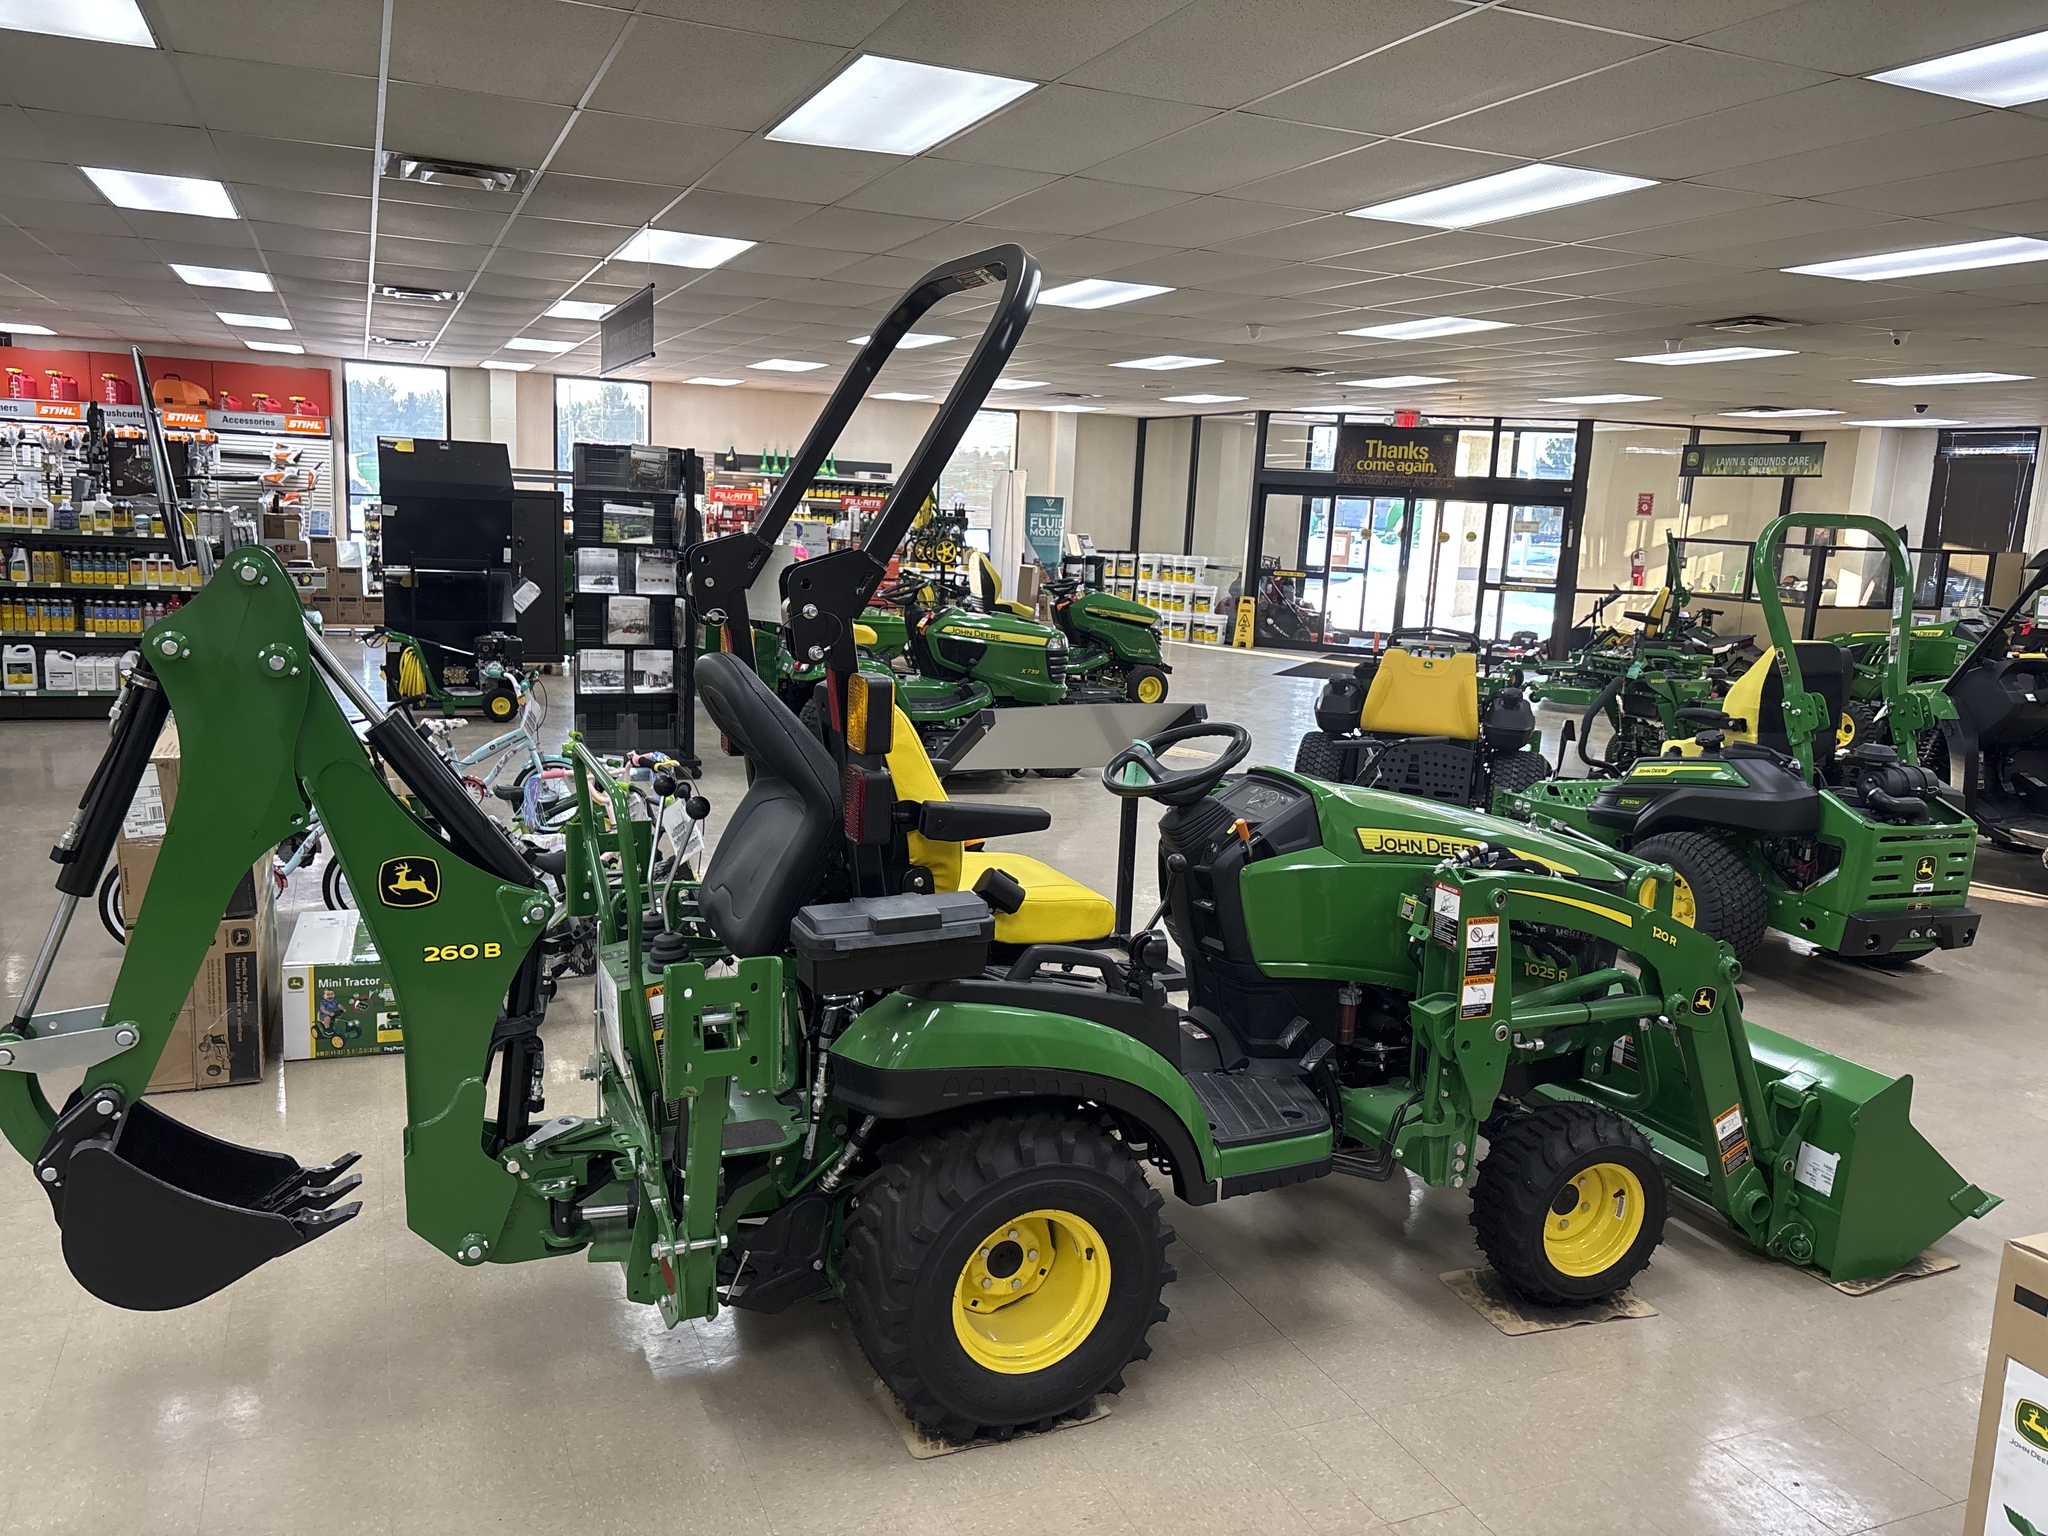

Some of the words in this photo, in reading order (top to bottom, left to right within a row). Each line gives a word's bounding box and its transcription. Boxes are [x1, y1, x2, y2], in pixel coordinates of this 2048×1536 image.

[39, 405, 76, 415] STIHL
[166, 412, 202, 422] STIHL
[222, 415, 276, 427] Accessories
[1397, 413, 1417, 428] EXIT
[288, 419, 322, 429] STIHL
[1365, 439, 1429, 460] Thanks
[1356, 460, 1395, 472] come
[1396, 460, 1437, 474] again.
[1716, 457, 1739, 466] LAWN
[1740, 457, 1746, 466] &
[1748, 456, 1786, 466] GROUNDS
[1788, 456, 1810, 466] CARE
[714, 491, 754, 501] FILL-RITE
[844, 498, 882, 507] FILL-RITE
[1030, 518, 1064, 529] FLUID
[1029, 528, 1061, 537] MOTIO
[275, 544, 297, 553] DEF
[949, 627, 974, 637] JOHN
[974, 631, 1001, 641] DEERE
[1374, 835, 1423, 853] JOHN
[1426, 838, 1470, 856] DEE
[1443, 884, 1459, 894] DANGER
[1555, 928, 1580, 940] MSHA
[1652, 925, 1670, 942] 120
[1669, 935, 1677, 947] R
[424, 944, 479, 962] 260
[484, 942, 502, 958] B
[1524, 961, 1556, 980] 1025
[1558, 970, 1568, 982] R
[318, 978, 342, 988] Mini
[343, 976, 381, 987] Tractor
[236, 1008, 241, 1016] en
[2008, 1437, 2030, 1455] JOHN
